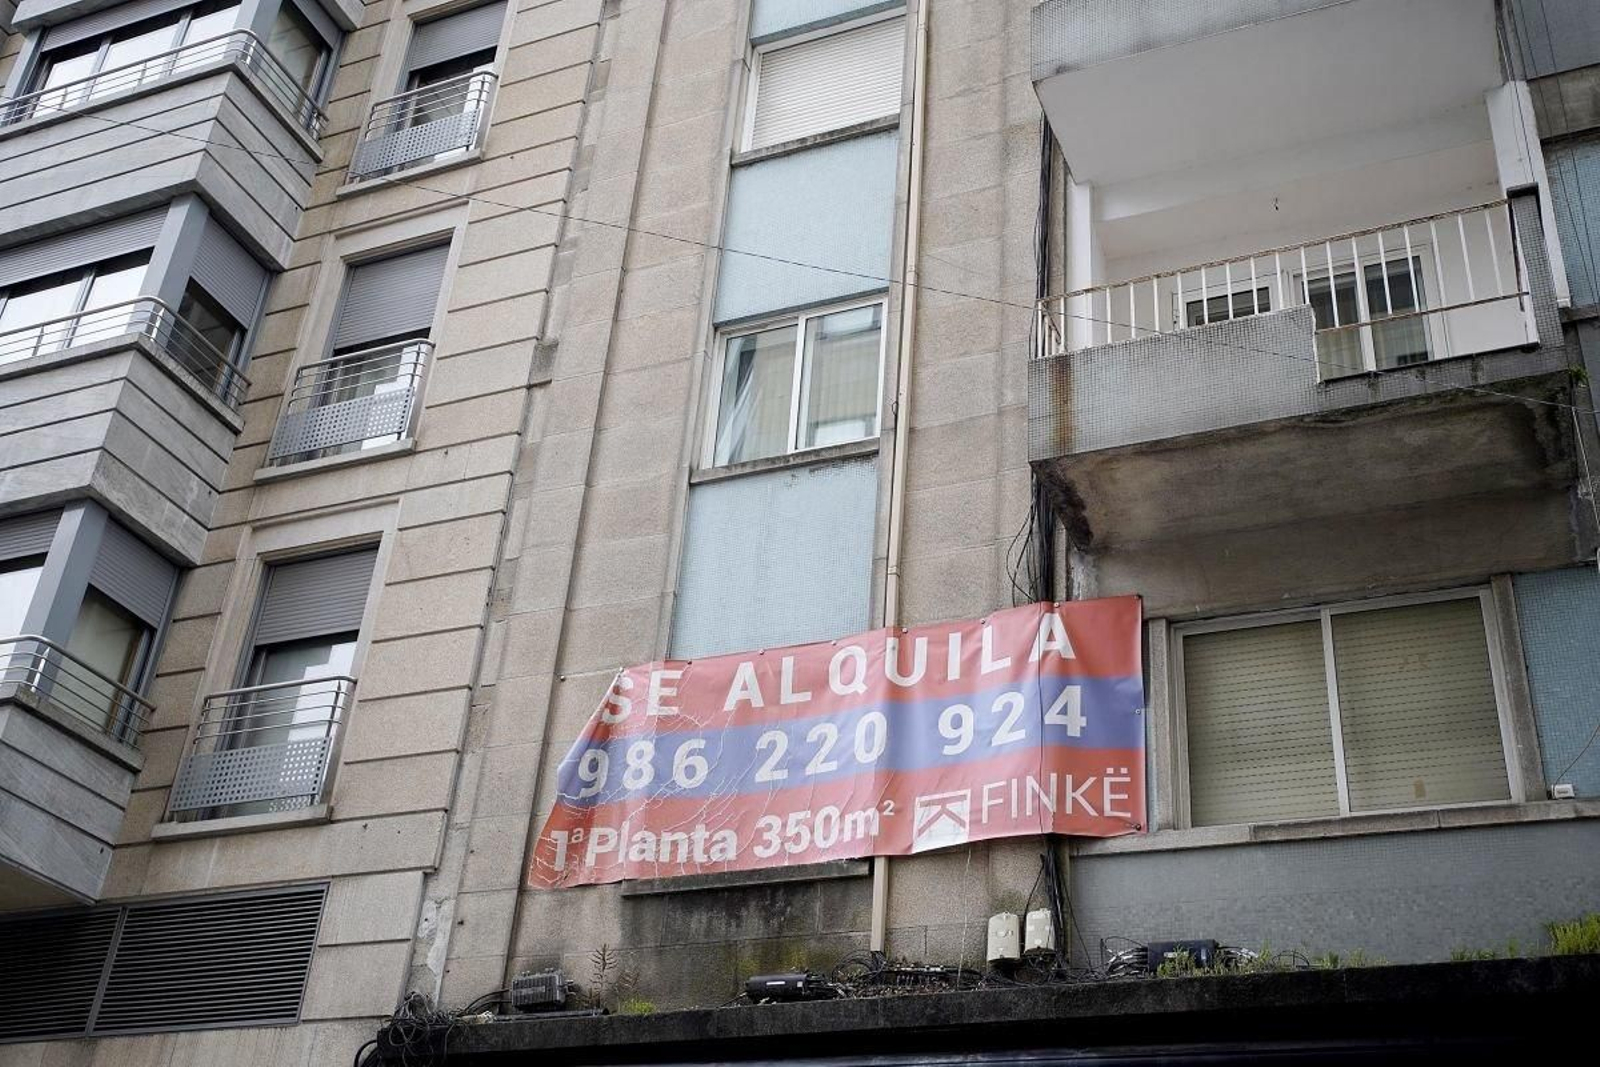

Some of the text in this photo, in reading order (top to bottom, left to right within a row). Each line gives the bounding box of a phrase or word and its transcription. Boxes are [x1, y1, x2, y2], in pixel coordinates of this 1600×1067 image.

[600, 612, 1076, 724] SE ALQUILA
[577, 685, 1087, 798] 986 220 924
[981, 767, 1132, 824] FINKË
